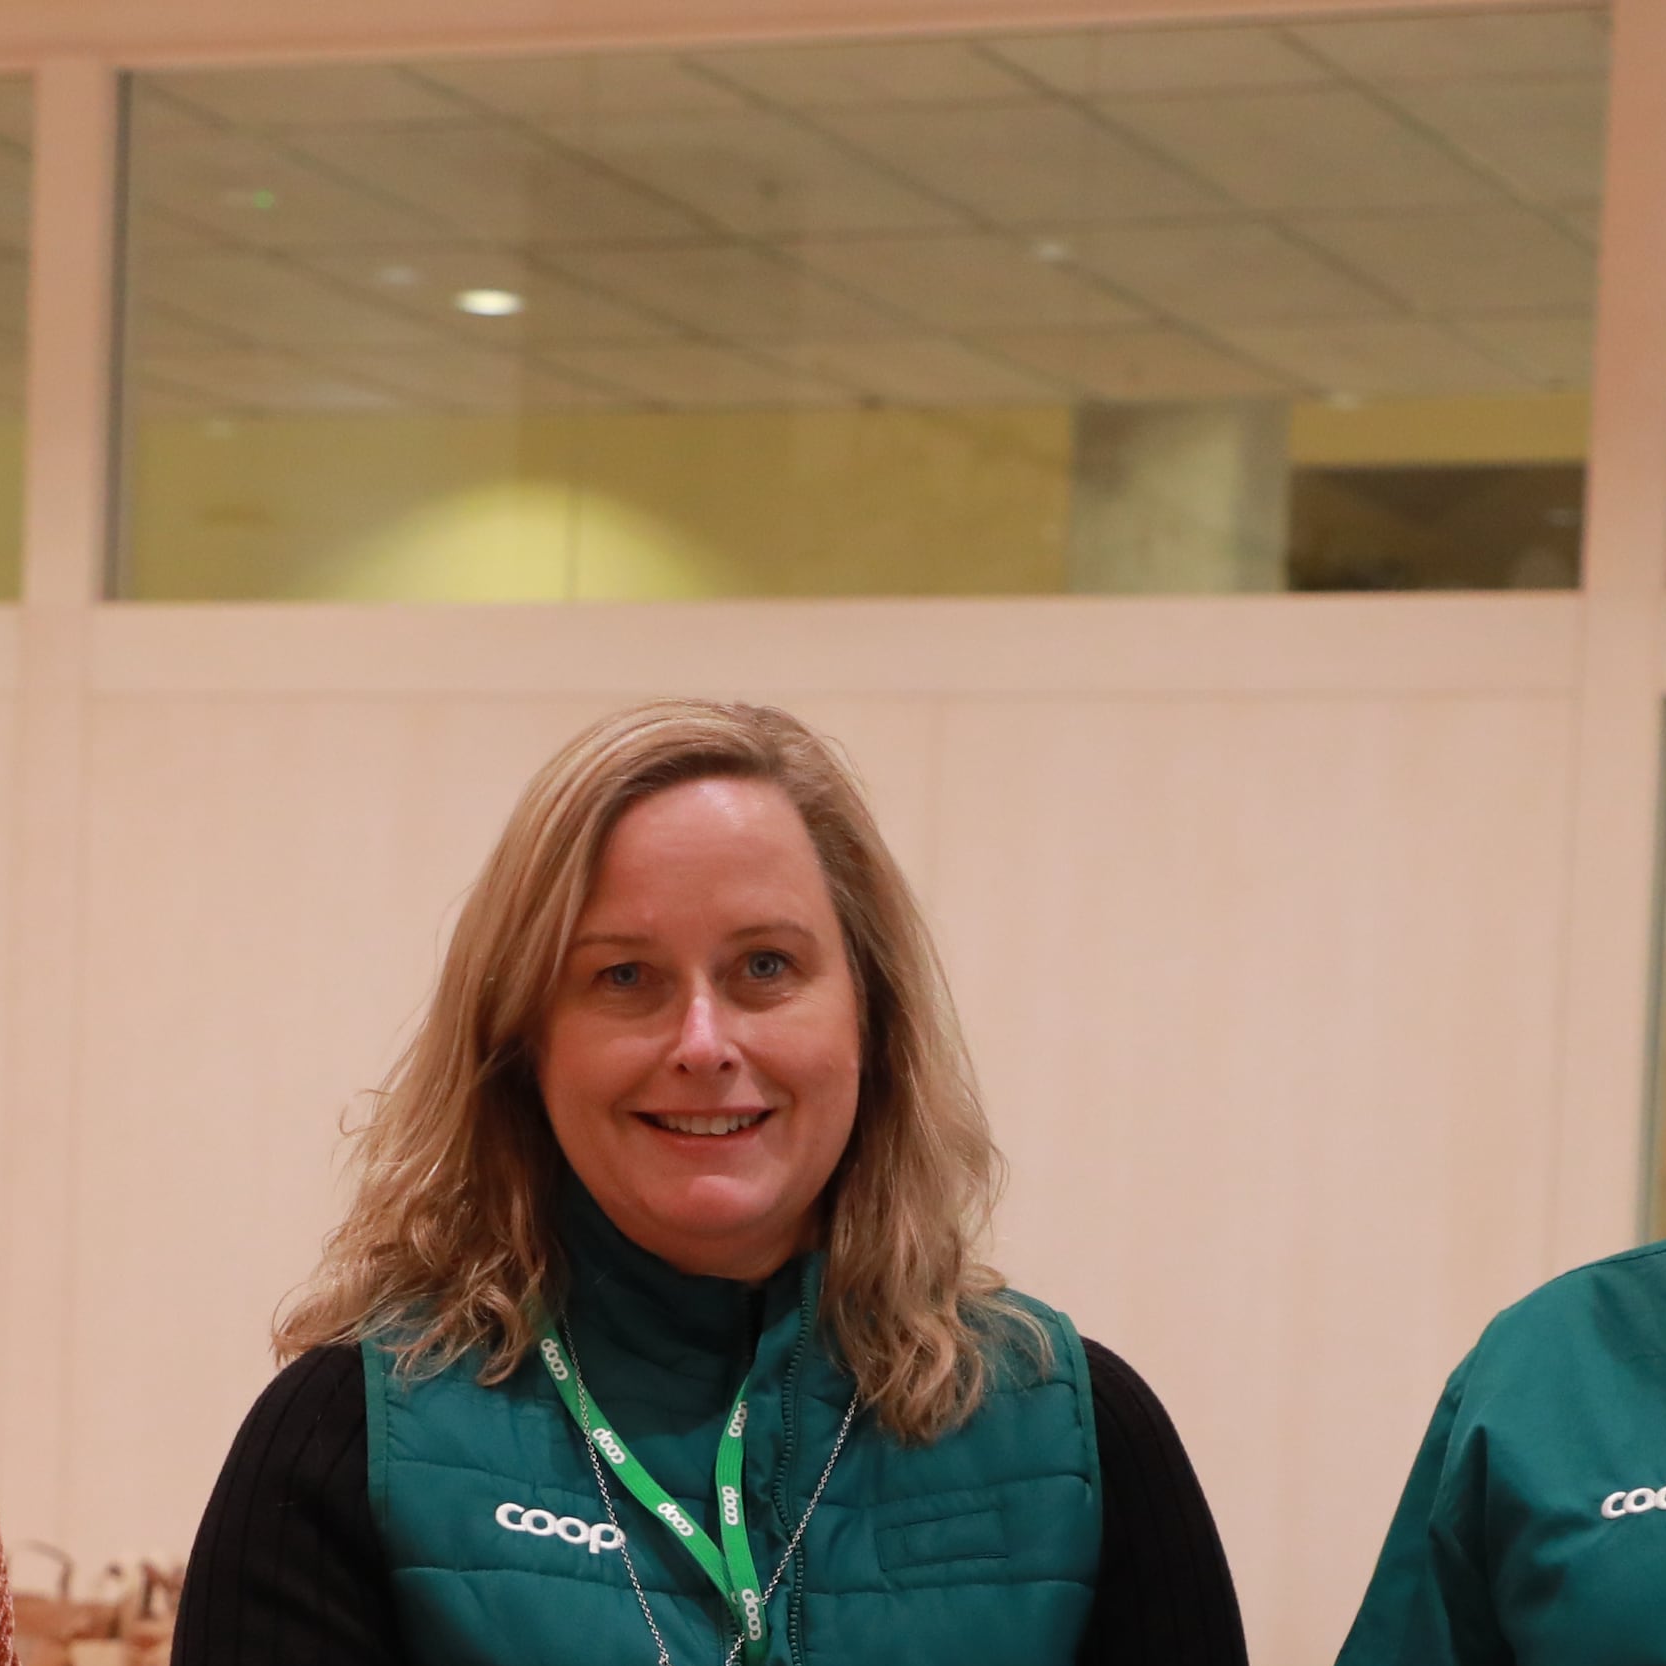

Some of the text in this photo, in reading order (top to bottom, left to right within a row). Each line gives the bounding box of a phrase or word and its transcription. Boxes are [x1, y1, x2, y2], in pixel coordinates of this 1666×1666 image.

[591, 1427, 627, 1466] coop
[657, 1501, 695, 1538] coop
[721, 1484, 740, 1527] coop
[495, 1502, 627, 1555] coop
[741, 1587, 764, 1641] coop
